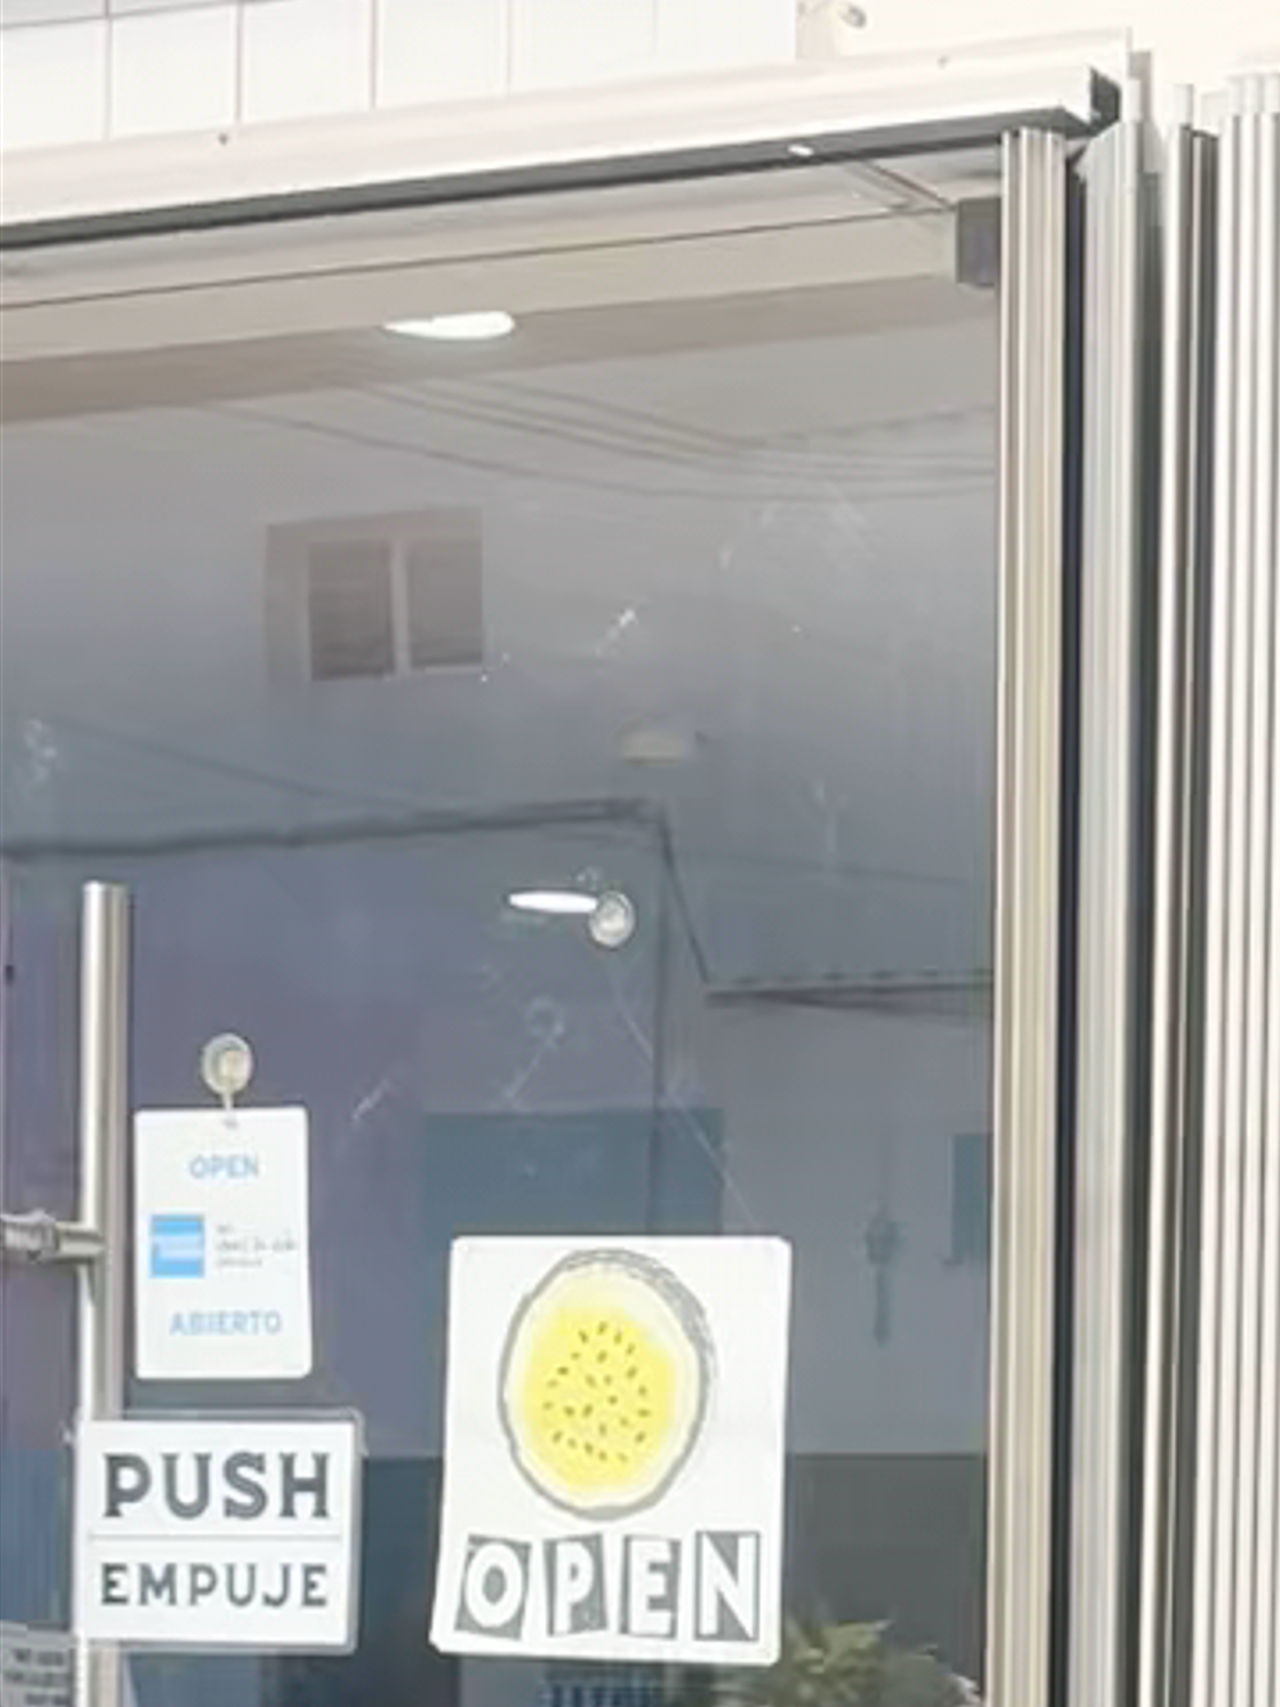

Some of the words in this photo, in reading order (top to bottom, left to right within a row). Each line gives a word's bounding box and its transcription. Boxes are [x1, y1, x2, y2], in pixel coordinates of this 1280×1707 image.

[189, 1154, 259, 1180] OPEN
[169, 1310, 283, 1336] ABIERTO
[103, 1452, 331, 1519] PUSH
[101, 1563, 329, 1608] EMPUJE
[456, 1533, 761, 1641] OPEN
